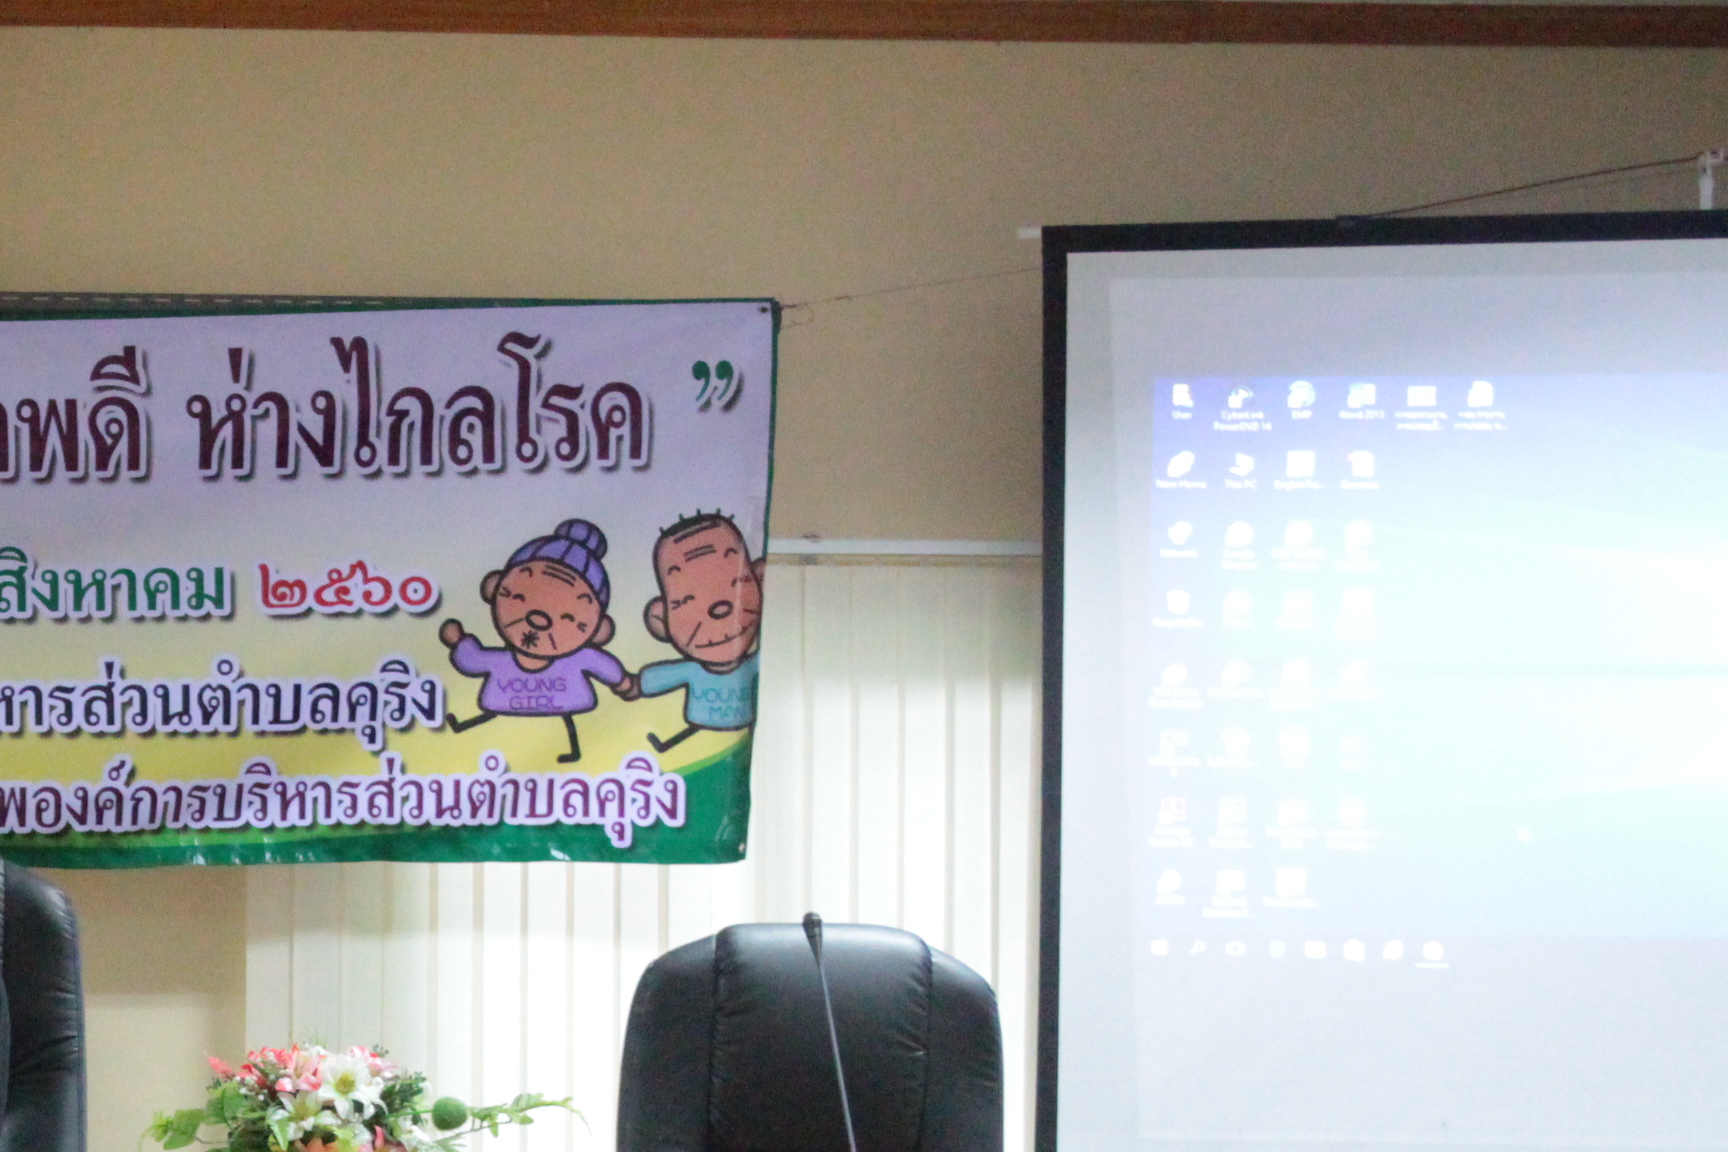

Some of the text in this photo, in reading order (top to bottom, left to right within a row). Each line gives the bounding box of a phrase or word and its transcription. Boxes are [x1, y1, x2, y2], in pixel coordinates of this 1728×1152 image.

[186, 332, 649, 476] ห่างไกลโรค
[259, 560, 432, 610] ๒๕๖๐
[497, 677, 566, 693] YOUNG
[508, 694, 564, 711] GIRL
